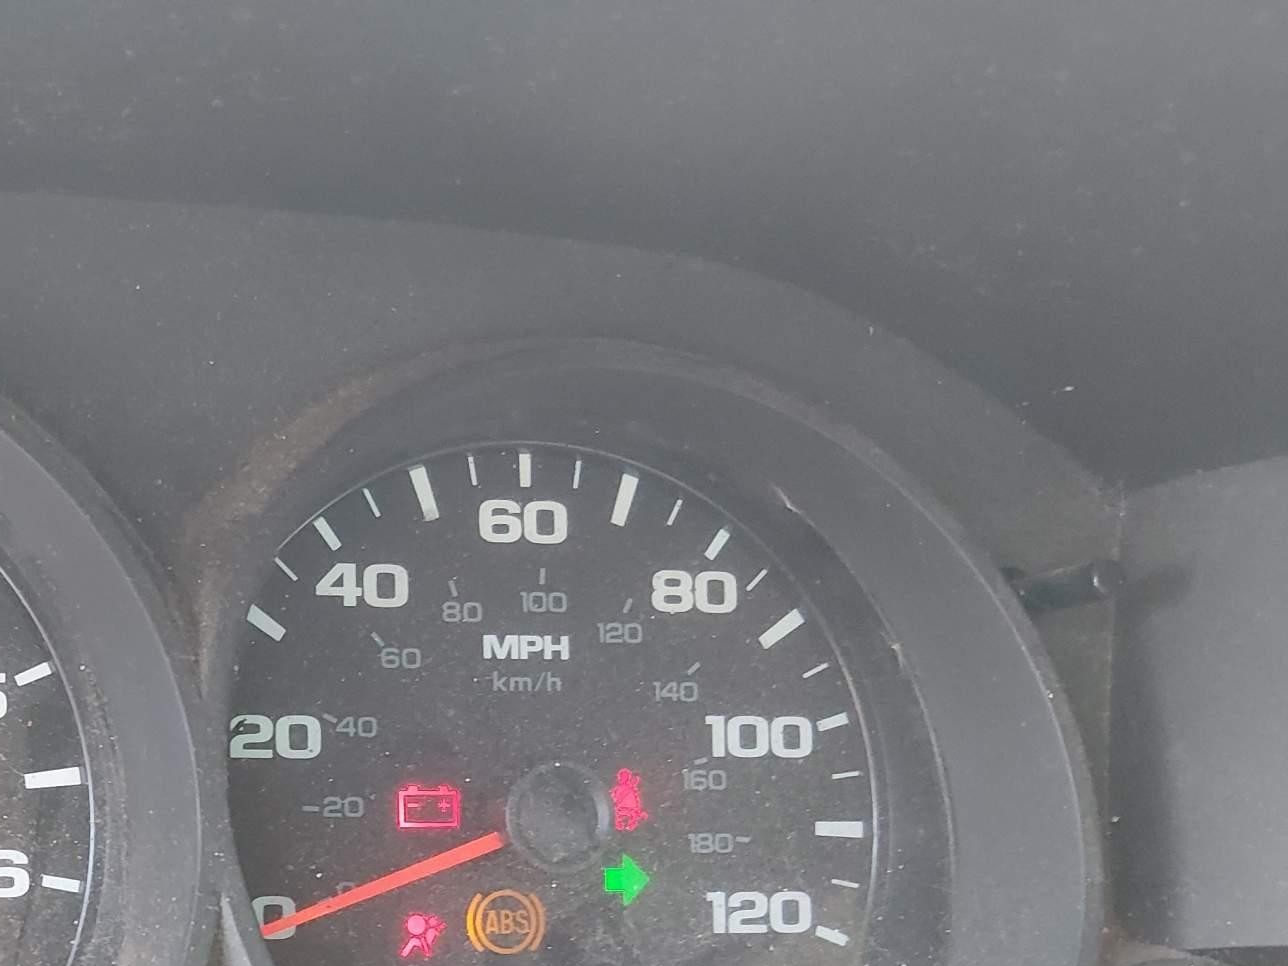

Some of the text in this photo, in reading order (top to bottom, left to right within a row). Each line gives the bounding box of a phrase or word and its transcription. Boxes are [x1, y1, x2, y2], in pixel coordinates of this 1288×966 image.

[478, 499, 568, 544] 60
[315, 563, 409, 608] 40
[651, 570, 738, 614] 80
[441, 601, 483, 623] 80
[519, 591, 568, 613] 100
[597, 622, 643, 644] 120
[380, 648, 422, 669] 60
[482, 634, 570, 661] MPH
[492, 670, 563, 692] km/h
[652, 681, 699, 702] 140
[229, 714, 322, 759] 20
[335, 716, 378, 738] 40
[704, 715, 813, 758] 100
[682, 769, 727, 791] 160
[322, 796, 365, 818] 20
[687, 832, 734, 854] 180
[485, 909, 529, 934] ABS
[706, 891, 812, 934] 120
